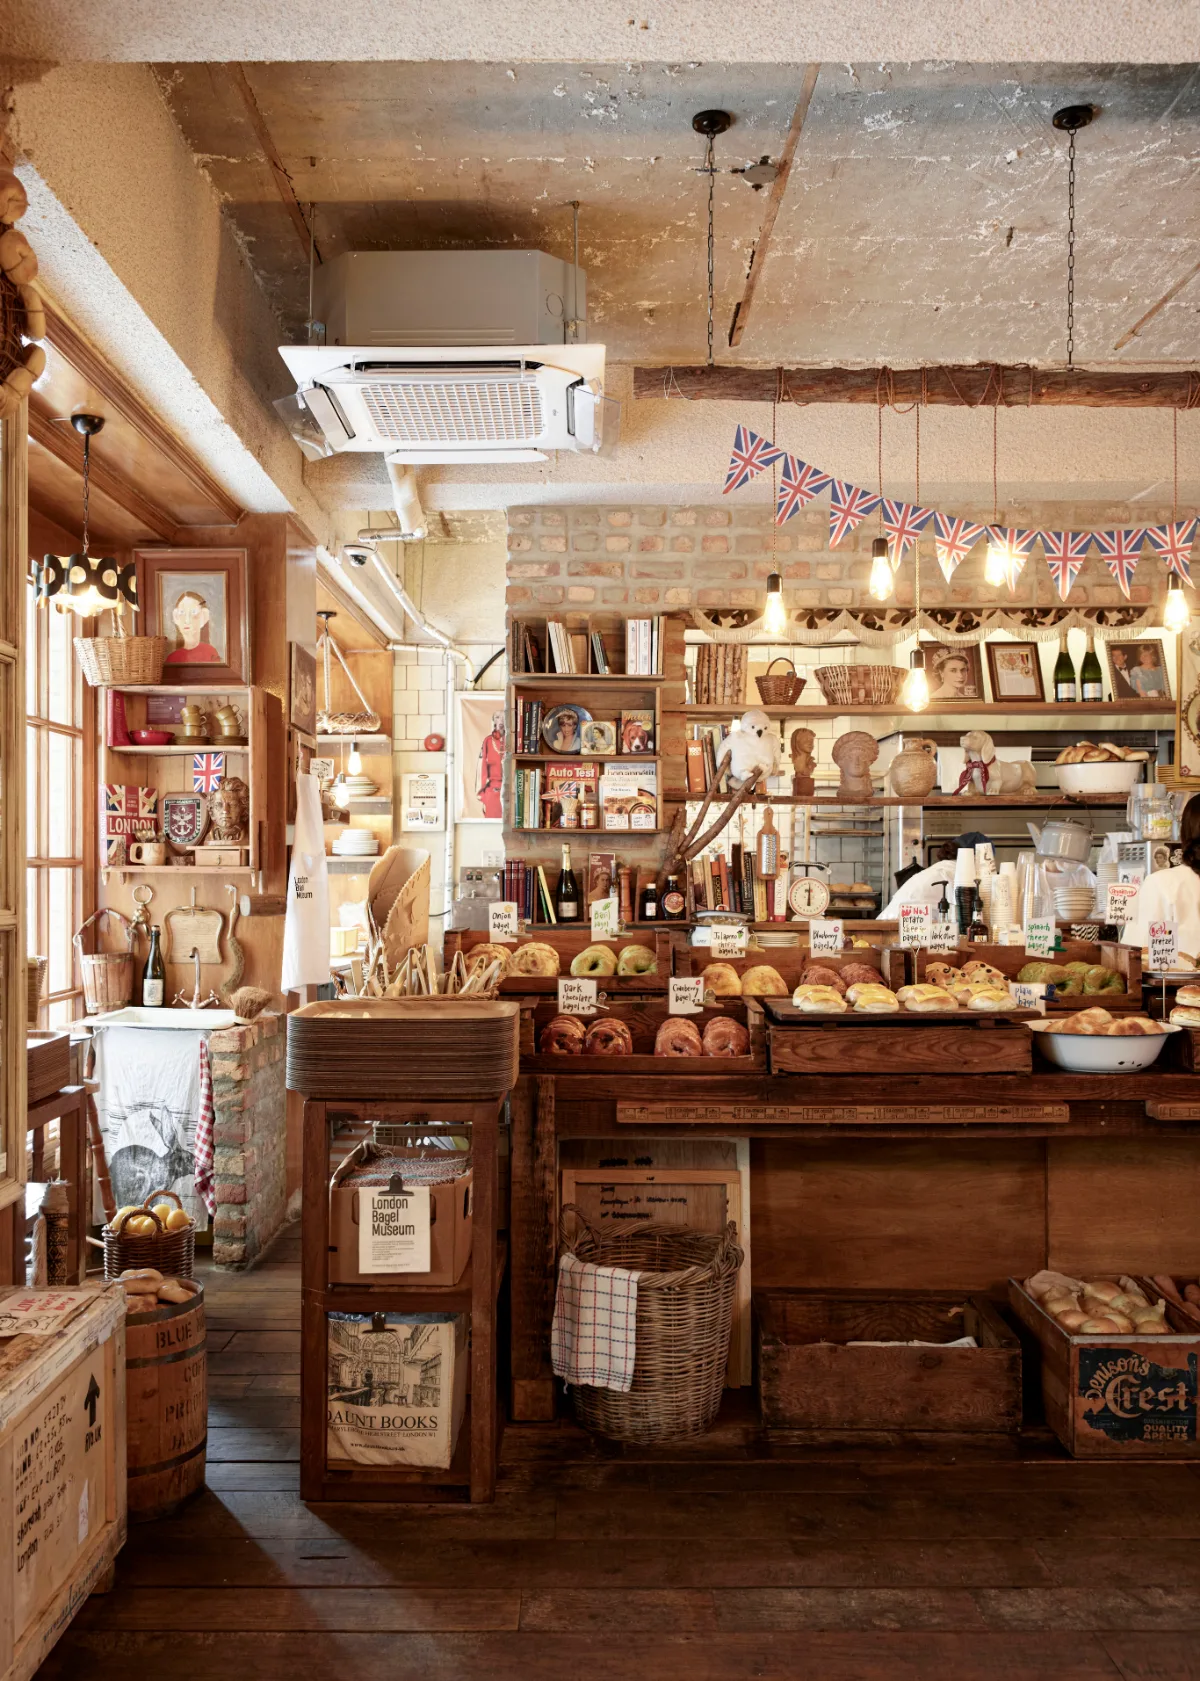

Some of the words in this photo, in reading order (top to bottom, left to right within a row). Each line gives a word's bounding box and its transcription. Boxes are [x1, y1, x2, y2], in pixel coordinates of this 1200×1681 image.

[549, 767, 573, 777] Auto
[573, 767, 595, 778] Test
[108, 816, 155, 834] LONDON
[1110, 896, 1127, 906] Brick
[492, 912, 511, 920] Onion
[902, 915, 924, 928] potato
[492, 921, 510, 932] bagel
[1151, 934, 1174, 949] pretzel
[1152, 947, 1175, 957] butter
[563, 982, 583, 993] Dark
[1014, 985, 1033, 998] plain
[562, 1001, 580, 1013] bagel
[371, 1196, 408, 1210] London
[371, 1209, 399, 1225] Bagel
[371, 1224, 415, 1237] Museum
[155, 1321, 192, 1349] BLUE
[1105, 1373, 1189, 1419] Crest
[381, 1415, 438, 1429] BOOKS
[1143, 1424, 1189, 1432] QUALITY
[1143, 1432, 1189, 1441] APPLES
